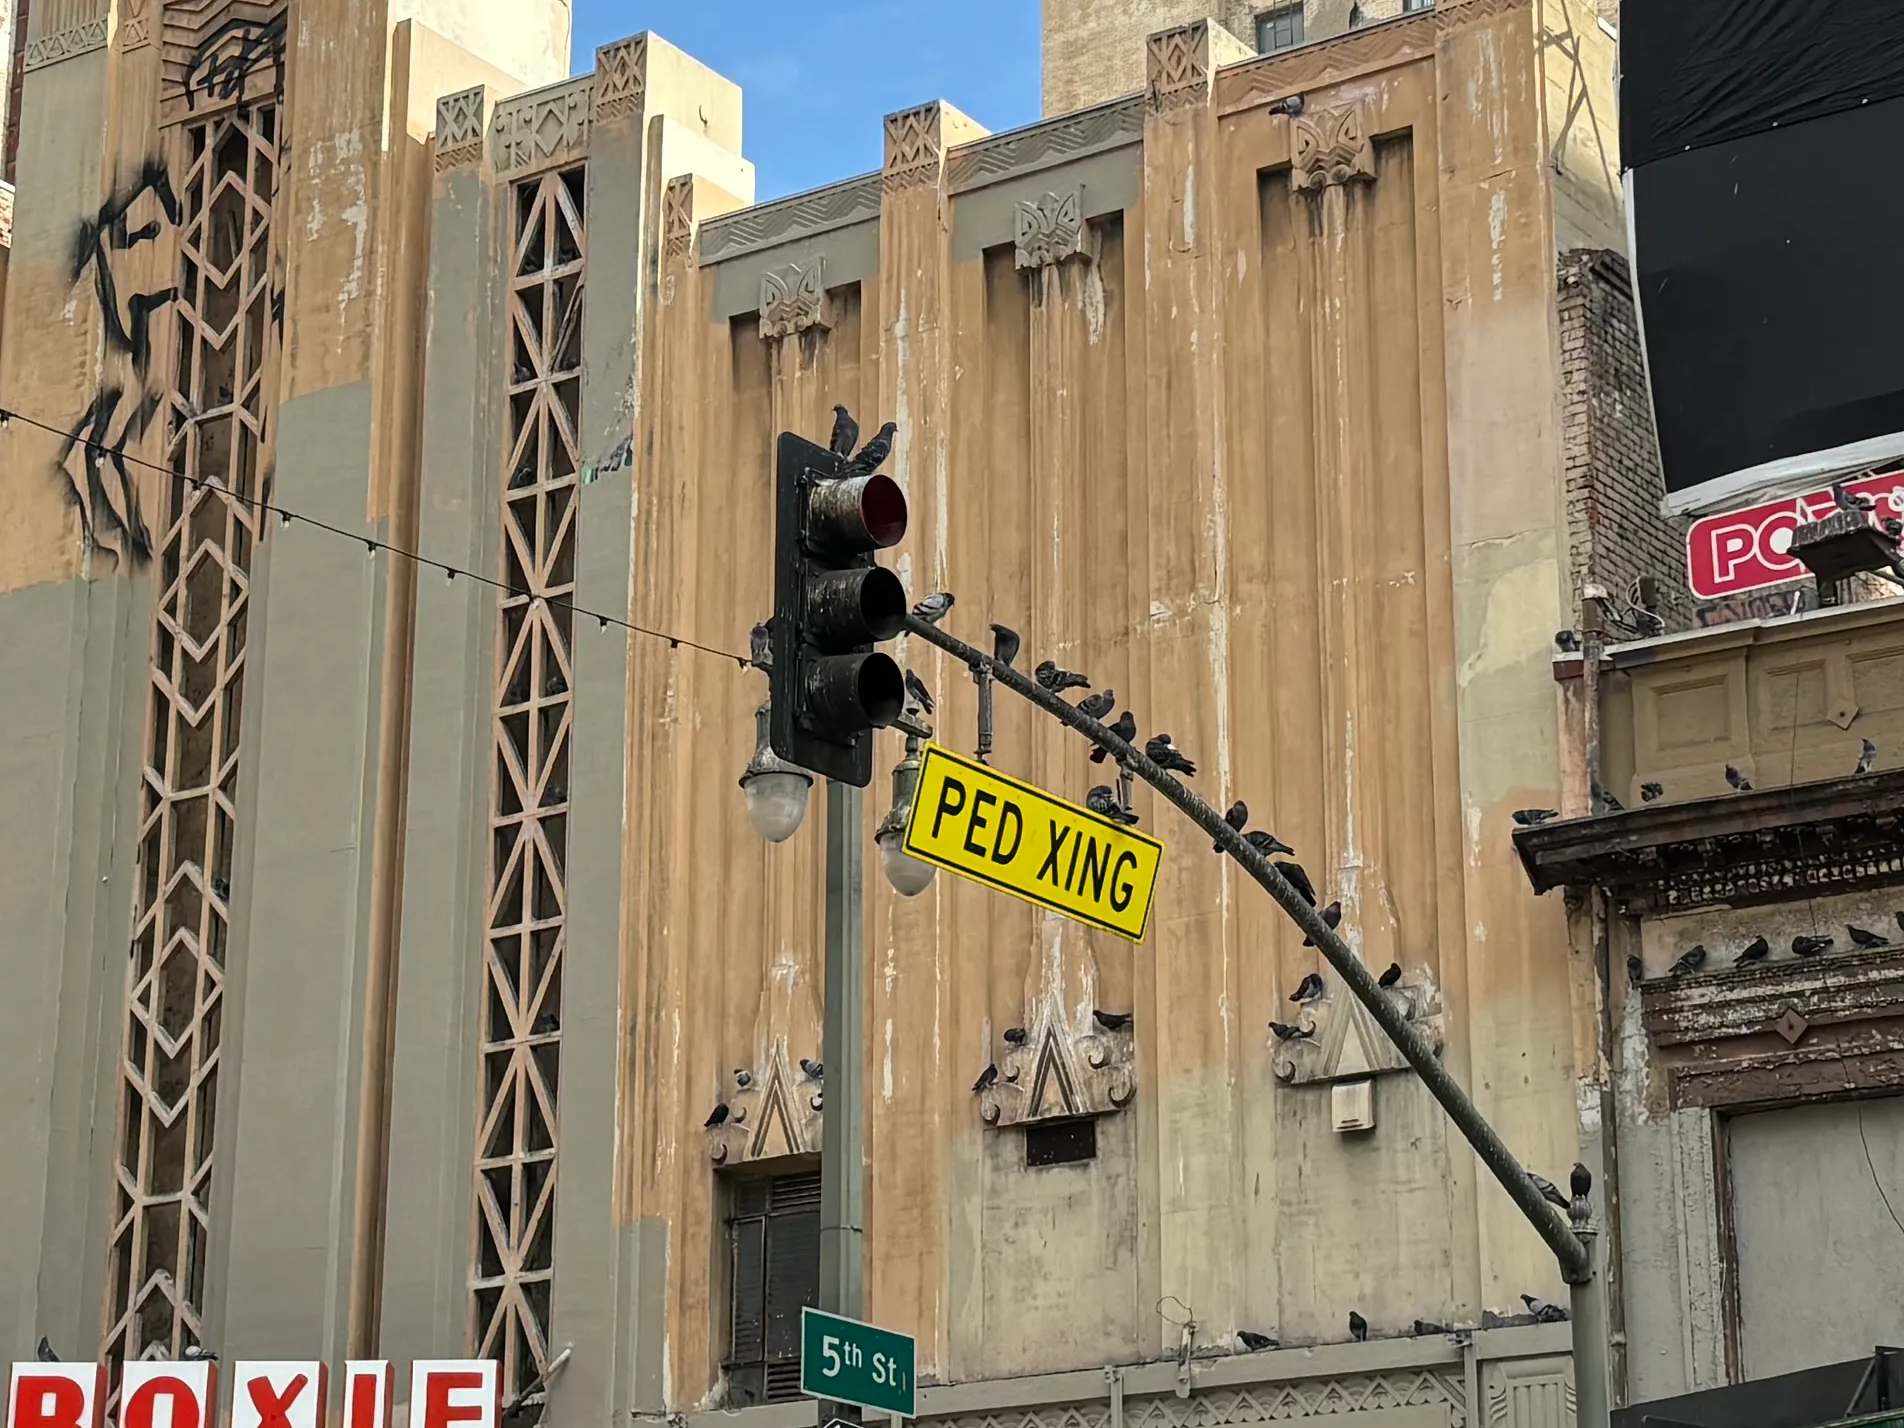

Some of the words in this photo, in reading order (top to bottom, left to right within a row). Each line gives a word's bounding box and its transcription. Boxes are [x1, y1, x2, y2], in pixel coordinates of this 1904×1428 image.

[931, 775, 1025, 866] PED
[1038, 824, 1139, 914] XING
[822, 1334, 862, 1378] 5th
[872, 1352, 897, 1387] St
